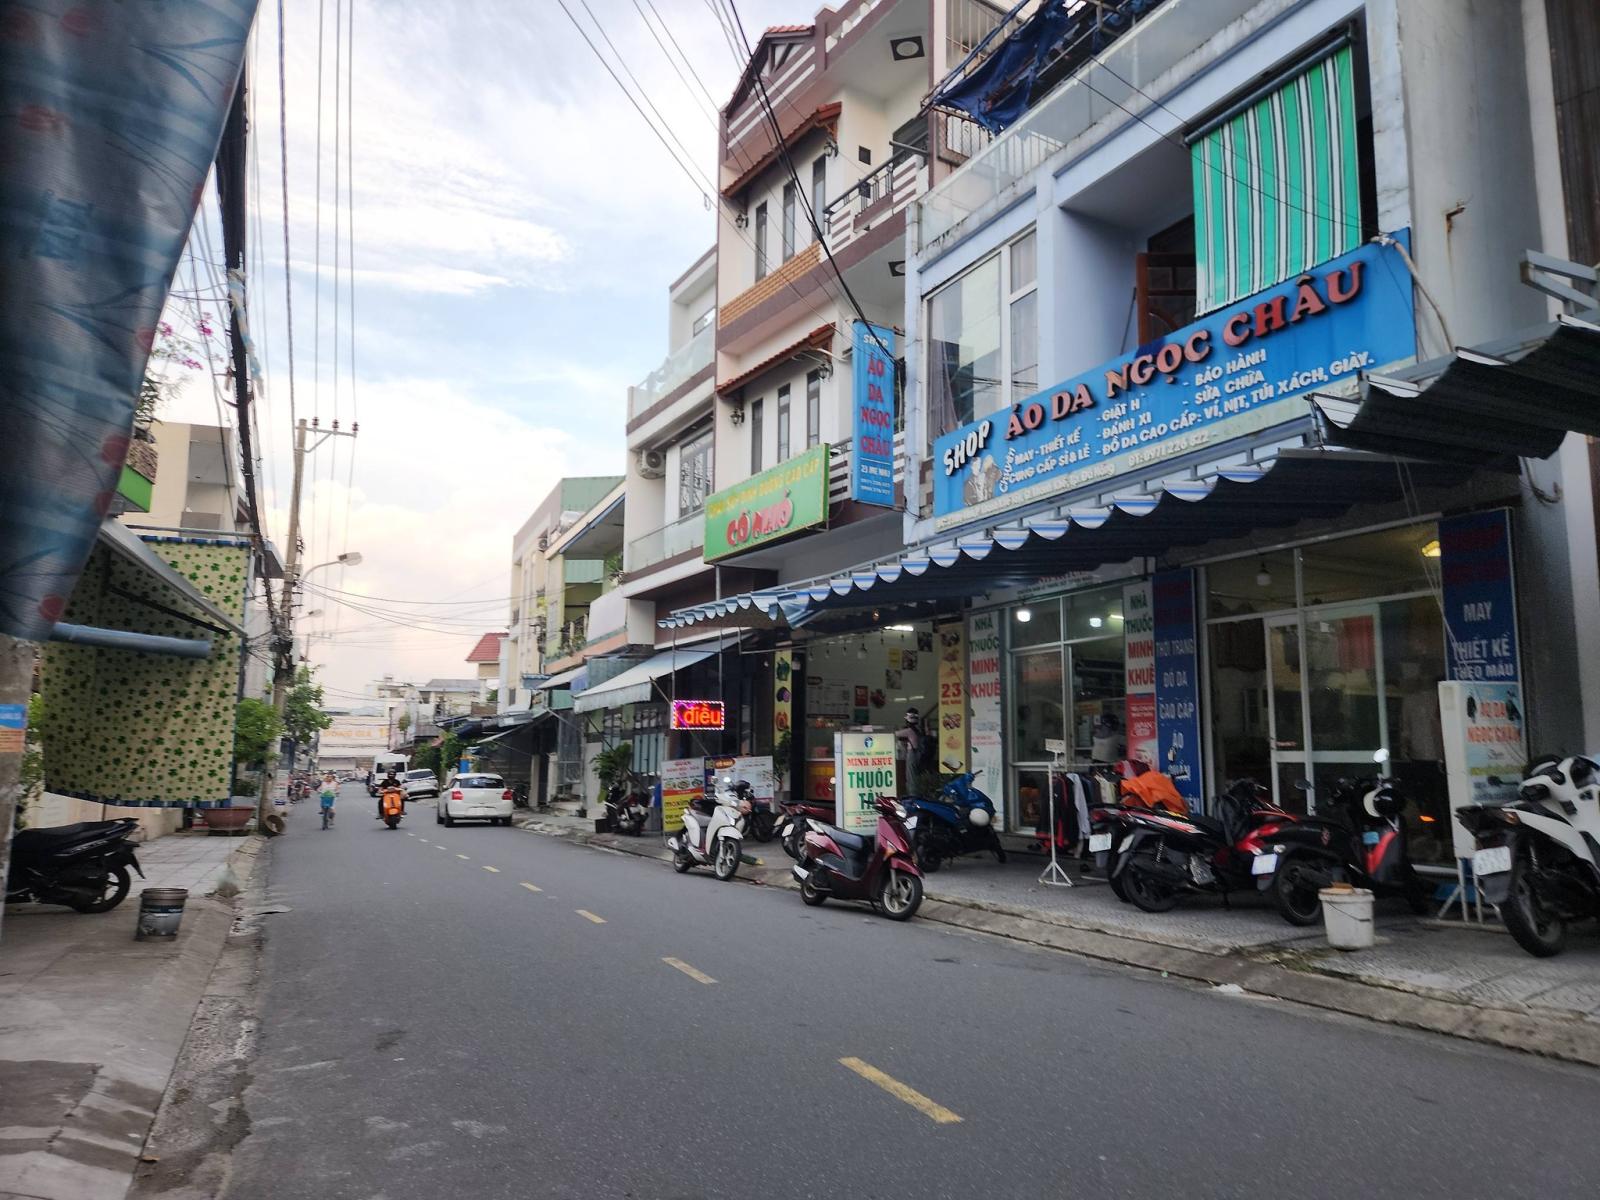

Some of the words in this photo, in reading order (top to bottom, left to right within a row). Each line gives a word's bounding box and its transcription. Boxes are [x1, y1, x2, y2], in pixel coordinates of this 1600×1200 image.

[943, 420, 990, 476] SHOP
[1004, 403, 1043, 440] ÁO
[1052, 383, 1094, 421] DA
[1105, 331, 1211, 398] NGỌC
[1223, 261, 1364, 347] CHÂU
[1226, 349, 1267, 374] HÀNH
[1122, 434, 1138, 449] DA
[1139, 425, 1168, 441] CAO
[1009, 467, 1035, 484] CUNG
[1463, 602, 1492, 622] MAY
[1128, 639, 1154, 659] MINH
[971, 658, 999, 675] MINH
[942, 683, 961, 698] 23
[847, 768, 893, 789] THUỐC
